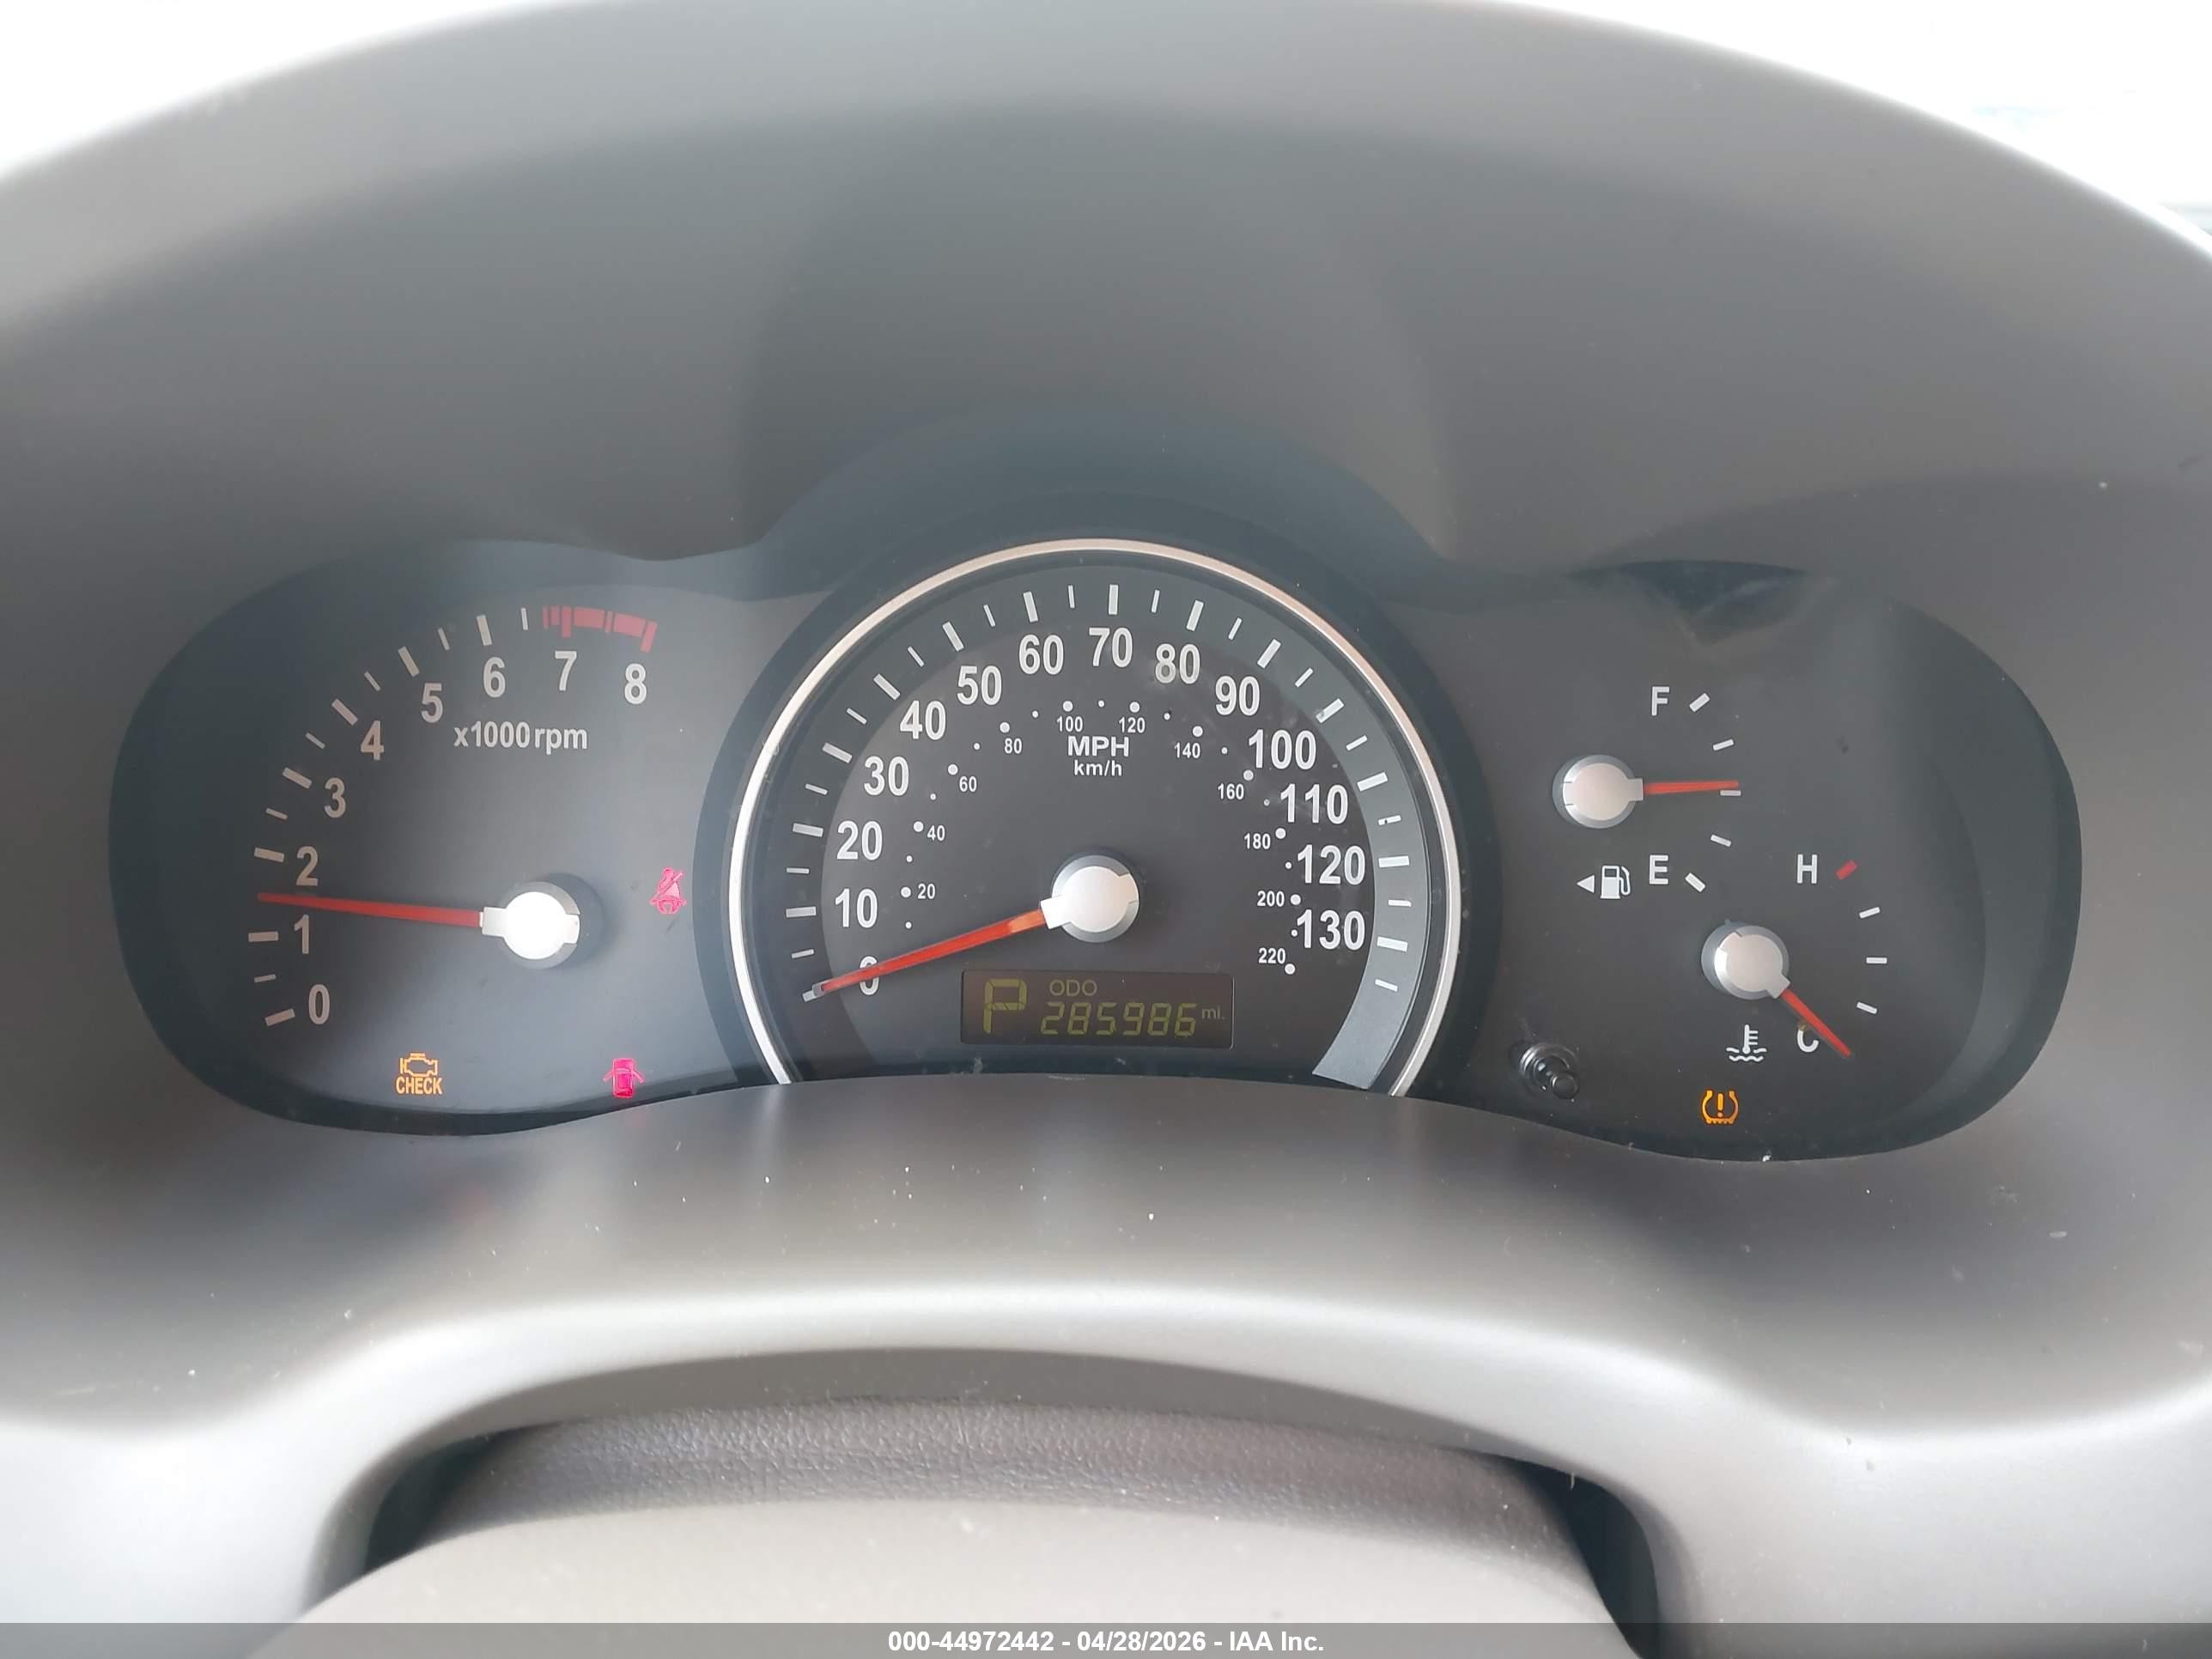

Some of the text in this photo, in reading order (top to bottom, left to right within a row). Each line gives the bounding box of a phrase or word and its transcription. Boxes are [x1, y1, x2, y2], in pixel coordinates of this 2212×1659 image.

[1019, 635, 1063, 674] 60
[1090, 628, 1132, 667] 70
[1156, 644, 1200, 684] 80
[483, 657, 505, 697] 6
[555, 651, 576, 690] 7
[625, 664, 647, 704] 8
[957, 665, 1001, 705] 50
[422, 684, 443, 723] 5
[1216, 676, 1260, 715] 90
[1652, 687, 1669, 715] F
[454, 721, 586, 754] x1000 rpm
[900, 701, 945, 739] 40
[1057, 716, 1083, 732] 100
[1119, 717, 1145, 732] 120
[361, 720, 384, 760] 4
[1005, 738, 1022, 754] 80
[1068, 736, 1128, 757] MPH
[1175, 743, 1200, 758] 140
[1249, 729, 1316, 769] 100
[864, 757, 908, 795] 30
[959, 776, 976, 792] 60
[1074, 760, 1121, 776] km/h
[325, 778, 346, 817] 3
[1218, 783, 1243, 799] 160
[1280, 784, 1347, 823] 110
[837, 821, 882, 860] 20
[927, 825, 945, 841] 40
[1244, 833, 1270, 849] 180
[296, 846, 318, 886] 2
[1297, 845, 1364, 884] 120
[1650, 855, 1668, 884] E
[1797, 854, 1817, 884] H
[836, 889, 877, 927] 10
[918, 884, 935, 899] 20
[1257, 890, 1285, 907] 200
[295, 915, 309, 954] 1
[1297, 909, 1364, 950] 130
[1259, 948, 1285, 963] 220
[309, 984, 330, 1024] 0
[983, 979, 1027, 1034] P
[1049, 980, 1097, 996] ODO
[1040, 1002, 1197, 1036] 285986
[397, 1075, 442, 1094] CHECK
